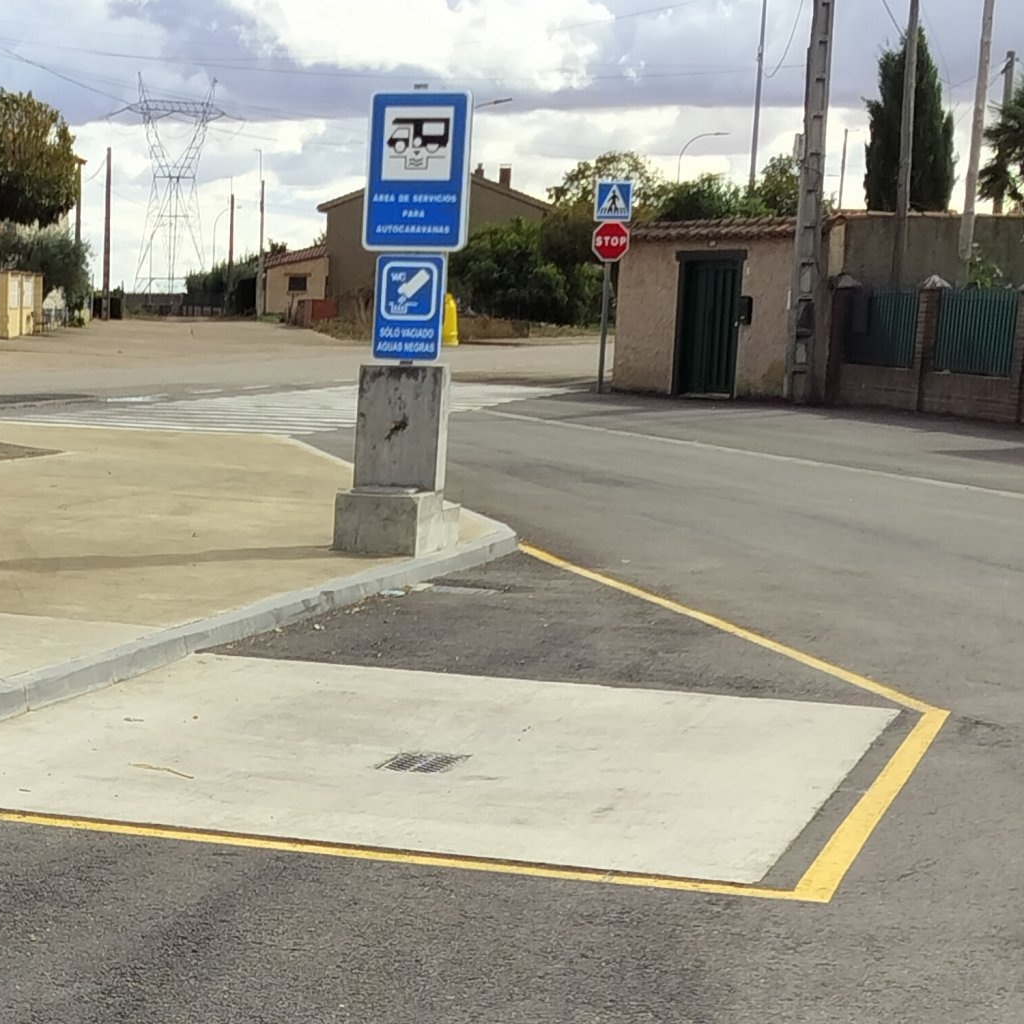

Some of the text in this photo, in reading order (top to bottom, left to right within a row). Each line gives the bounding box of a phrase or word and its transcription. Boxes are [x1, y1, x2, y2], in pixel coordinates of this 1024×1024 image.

[398, 193, 409, 203] DE
[412, 193, 457, 203] SERVICIOS
[401, 209, 425, 218] PARA
[376, 224, 450, 234] AUTOCARAVANAS
[595, 236, 627, 247] STOP
[391, 272, 407, 282] WC
[401, 327, 435, 339] VACIADO
[376, 340, 435, 353] AGUAS NEGRAS
